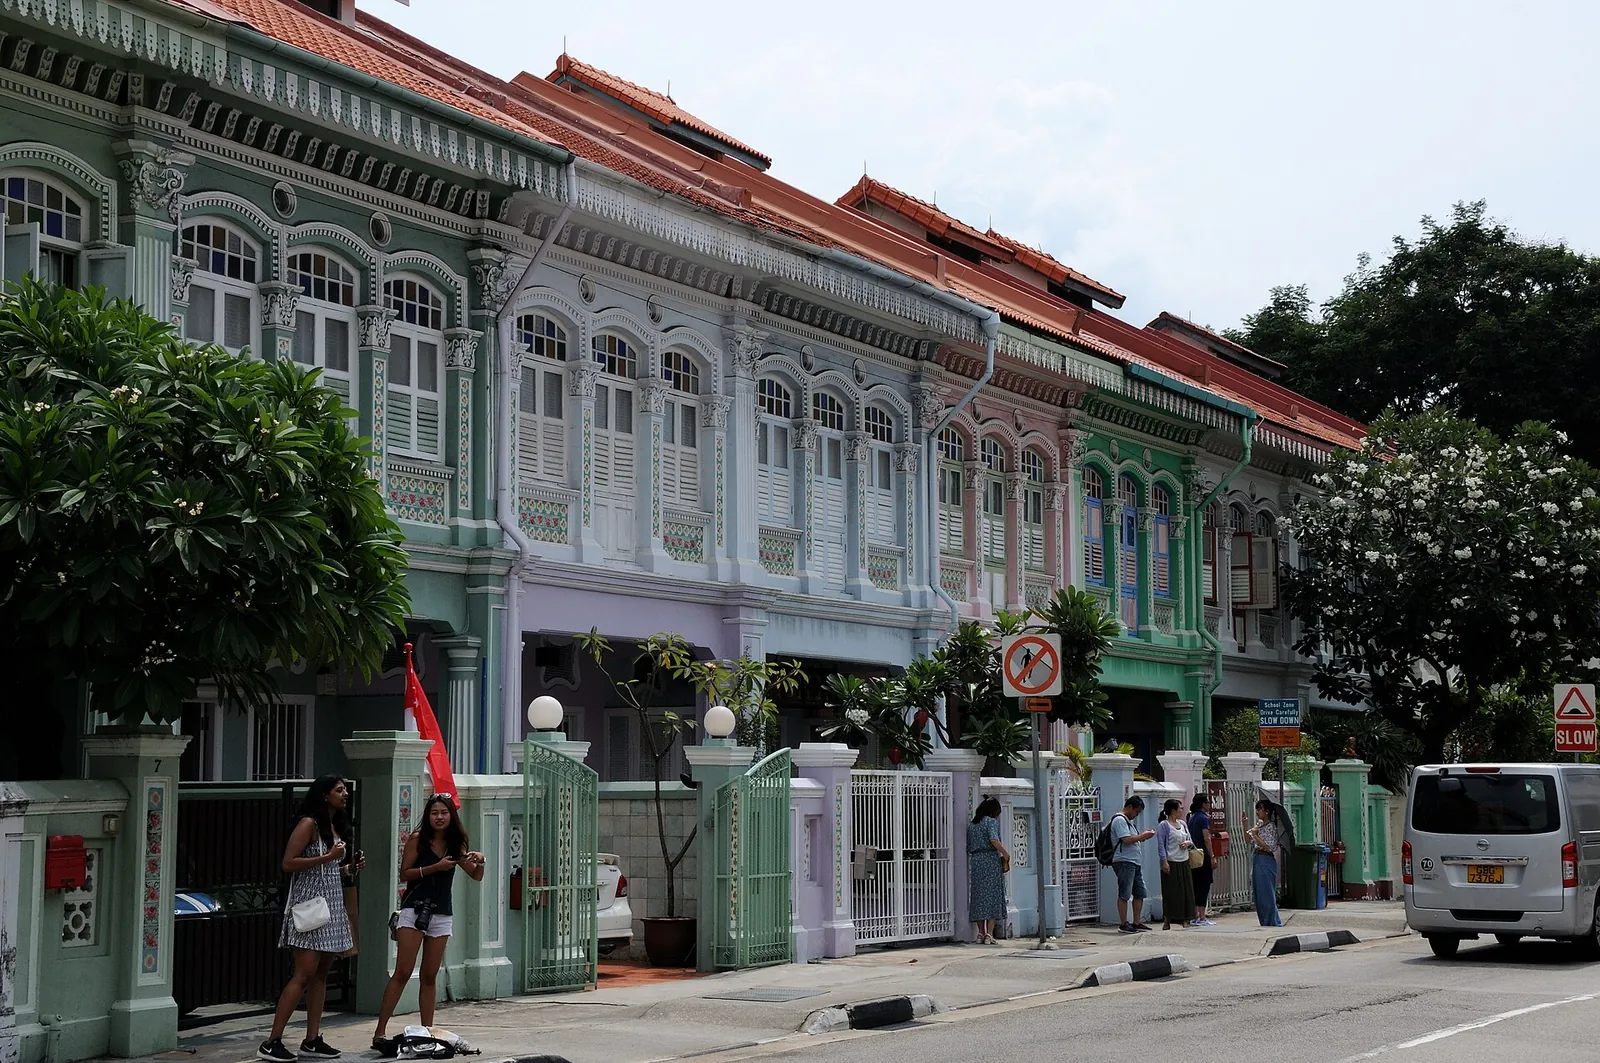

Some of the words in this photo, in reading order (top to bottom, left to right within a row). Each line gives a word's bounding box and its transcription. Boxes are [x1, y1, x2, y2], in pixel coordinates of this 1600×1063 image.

[1260, 716, 1278, 724] SLOW
[1279, 716, 1299, 724] DOWN
[1557, 729, 1594, 745] SLOW
[154, 759, 162, 773] 7
[1422, 860, 1433, 868] 70
[1476, 866, 1496, 875] GBG
